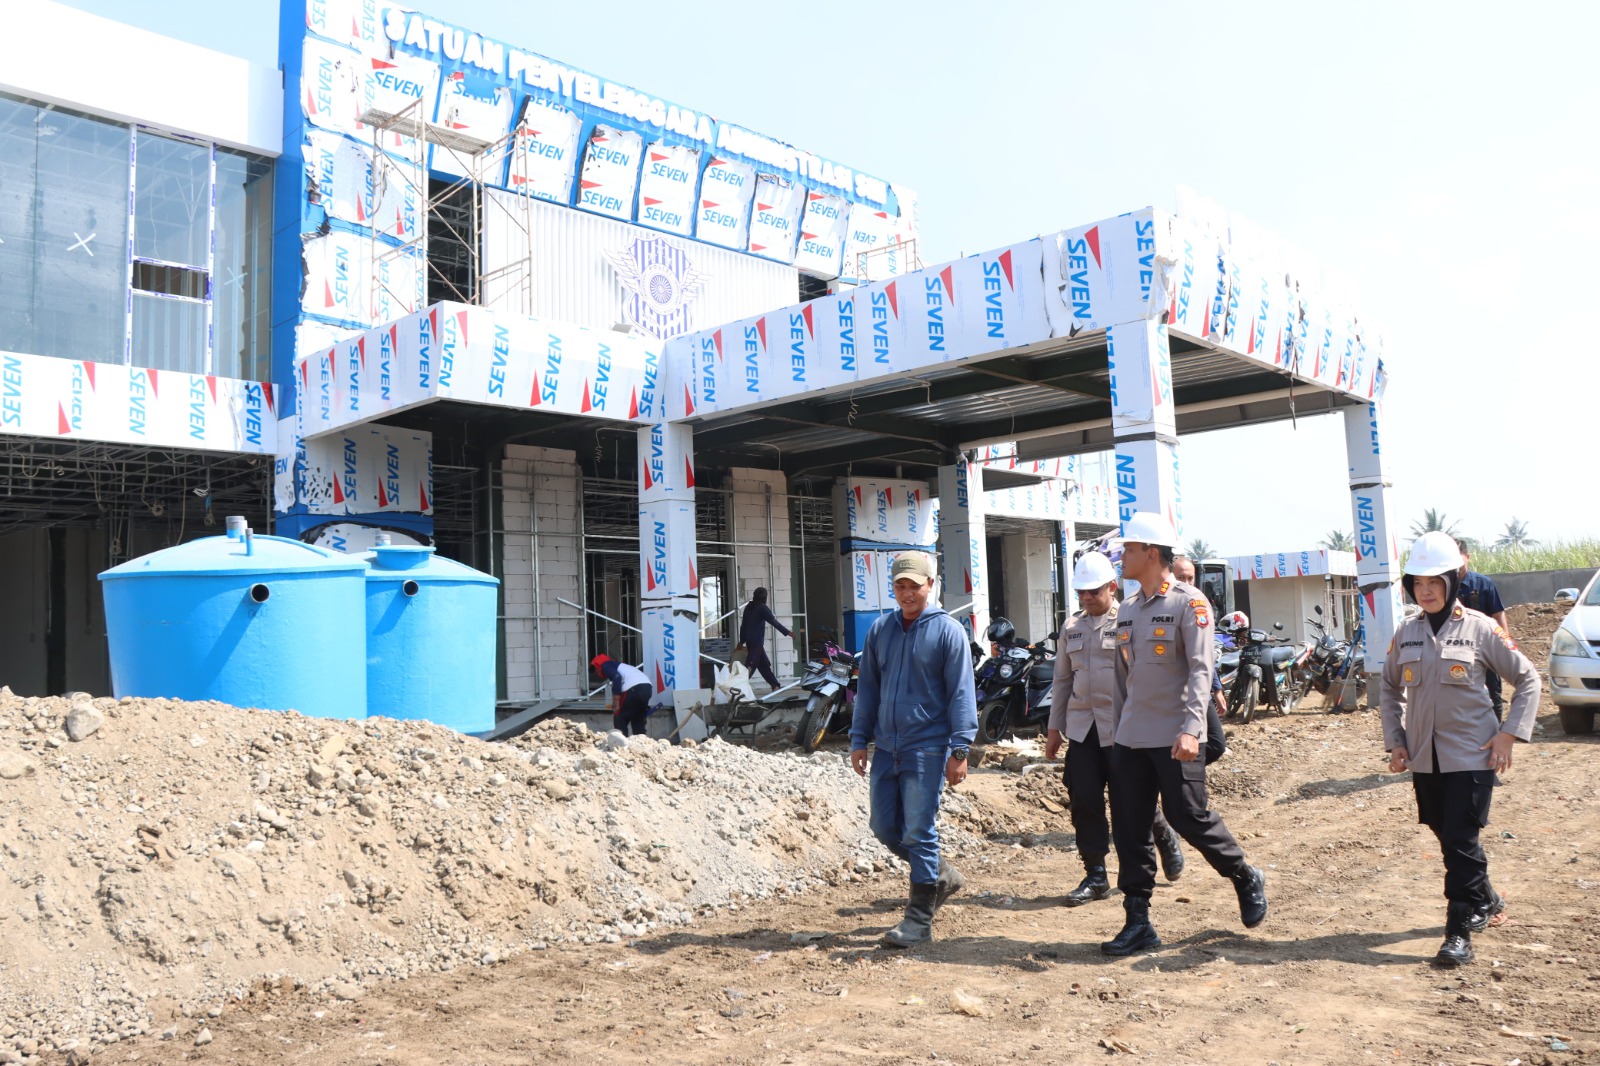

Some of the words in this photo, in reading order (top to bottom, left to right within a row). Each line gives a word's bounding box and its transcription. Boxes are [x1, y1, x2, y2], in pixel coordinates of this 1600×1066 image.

[384, 8, 504, 75] SATUAN
[317, 56, 334, 117] SEVEN
[374, 71, 424, 99] SEVEN
[320, 149, 334, 211] SEVEN
[589, 144, 630, 167] SEVEN
[650, 162, 689, 184] SEVEN
[708, 167, 745, 188] SEVEN
[404, 183, 415, 237] SEVEN
[582, 190, 623, 212] SEVEN
[643, 206, 682, 227] SEVEN
[702, 209, 738, 229] SEVEN
[757, 211, 790, 231] SEVEN
[809, 201, 840, 220] SEVEN
[335, 245, 349, 307] SEVEN
[803, 240, 834, 259] SEVEN
[1067, 237, 1092, 320] SEVEN
[925, 276, 945, 352] SEVEN
[983, 260, 1005, 341] SEVEN
[1177, 239, 1195, 326] SEVEN
[1225, 262, 1241, 343] SEVEN
[1255, 275, 1269, 354] SEVEN
[419, 317, 430, 389] SEVEN
[744, 325, 760, 393] SEVEN
[790, 313, 806, 382] SEVEN
[838, 300, 856, 371] SEVEN
[871, 291, 890, 364] SEVEN
[1319, 308, 1333, 378] SEVEN
[2, 355, 22, 428] SEVEN
[321, 356, 330, 421] SEVEN
[350, 345, 359, 411] SEVEN
[381, 333, 391, 401] SEVEN
[489, 324, 510, 398] SEVEN
[542, 333, 562, 405] SEVEN
[592, 342, 612, 411] SEVEN
[639, 351, 658, 418] SEVEN
[702, 337, 716, 403] SEVEN
[1156, 323, 1172, 405] SEVEN
[129, 368, 146, 435] SEVEN
[189, 374, 206, 441] SEVEN
[245, 381, 262, 445] SEVEN
[343, 438, 357, 502] SEVEN
[387, 444, 400, 505] SEVEN
[651, 422, 664, 484] SEVEN
[956, 462, 968, 508] SEVEN
[877, 489, 887, 533] SEVEN
[907, 490, 917, 533] SEVEN
[1115, 453, 1137, 537] EVEN
[1356, 496, 1376, 559] SEVEN
[654, 521, 666, 586] SEVEN
[855, 556, 866, 600] SEVEN
[971, 538, 981, 590] SEVEN
[1068, 632, 1083, 640] SIGIT
[1151, 615, 1174, 623] POLRI
[1446, 639, 1475, 647] POLRI
[663, 623, 676, 690] SEVEN
